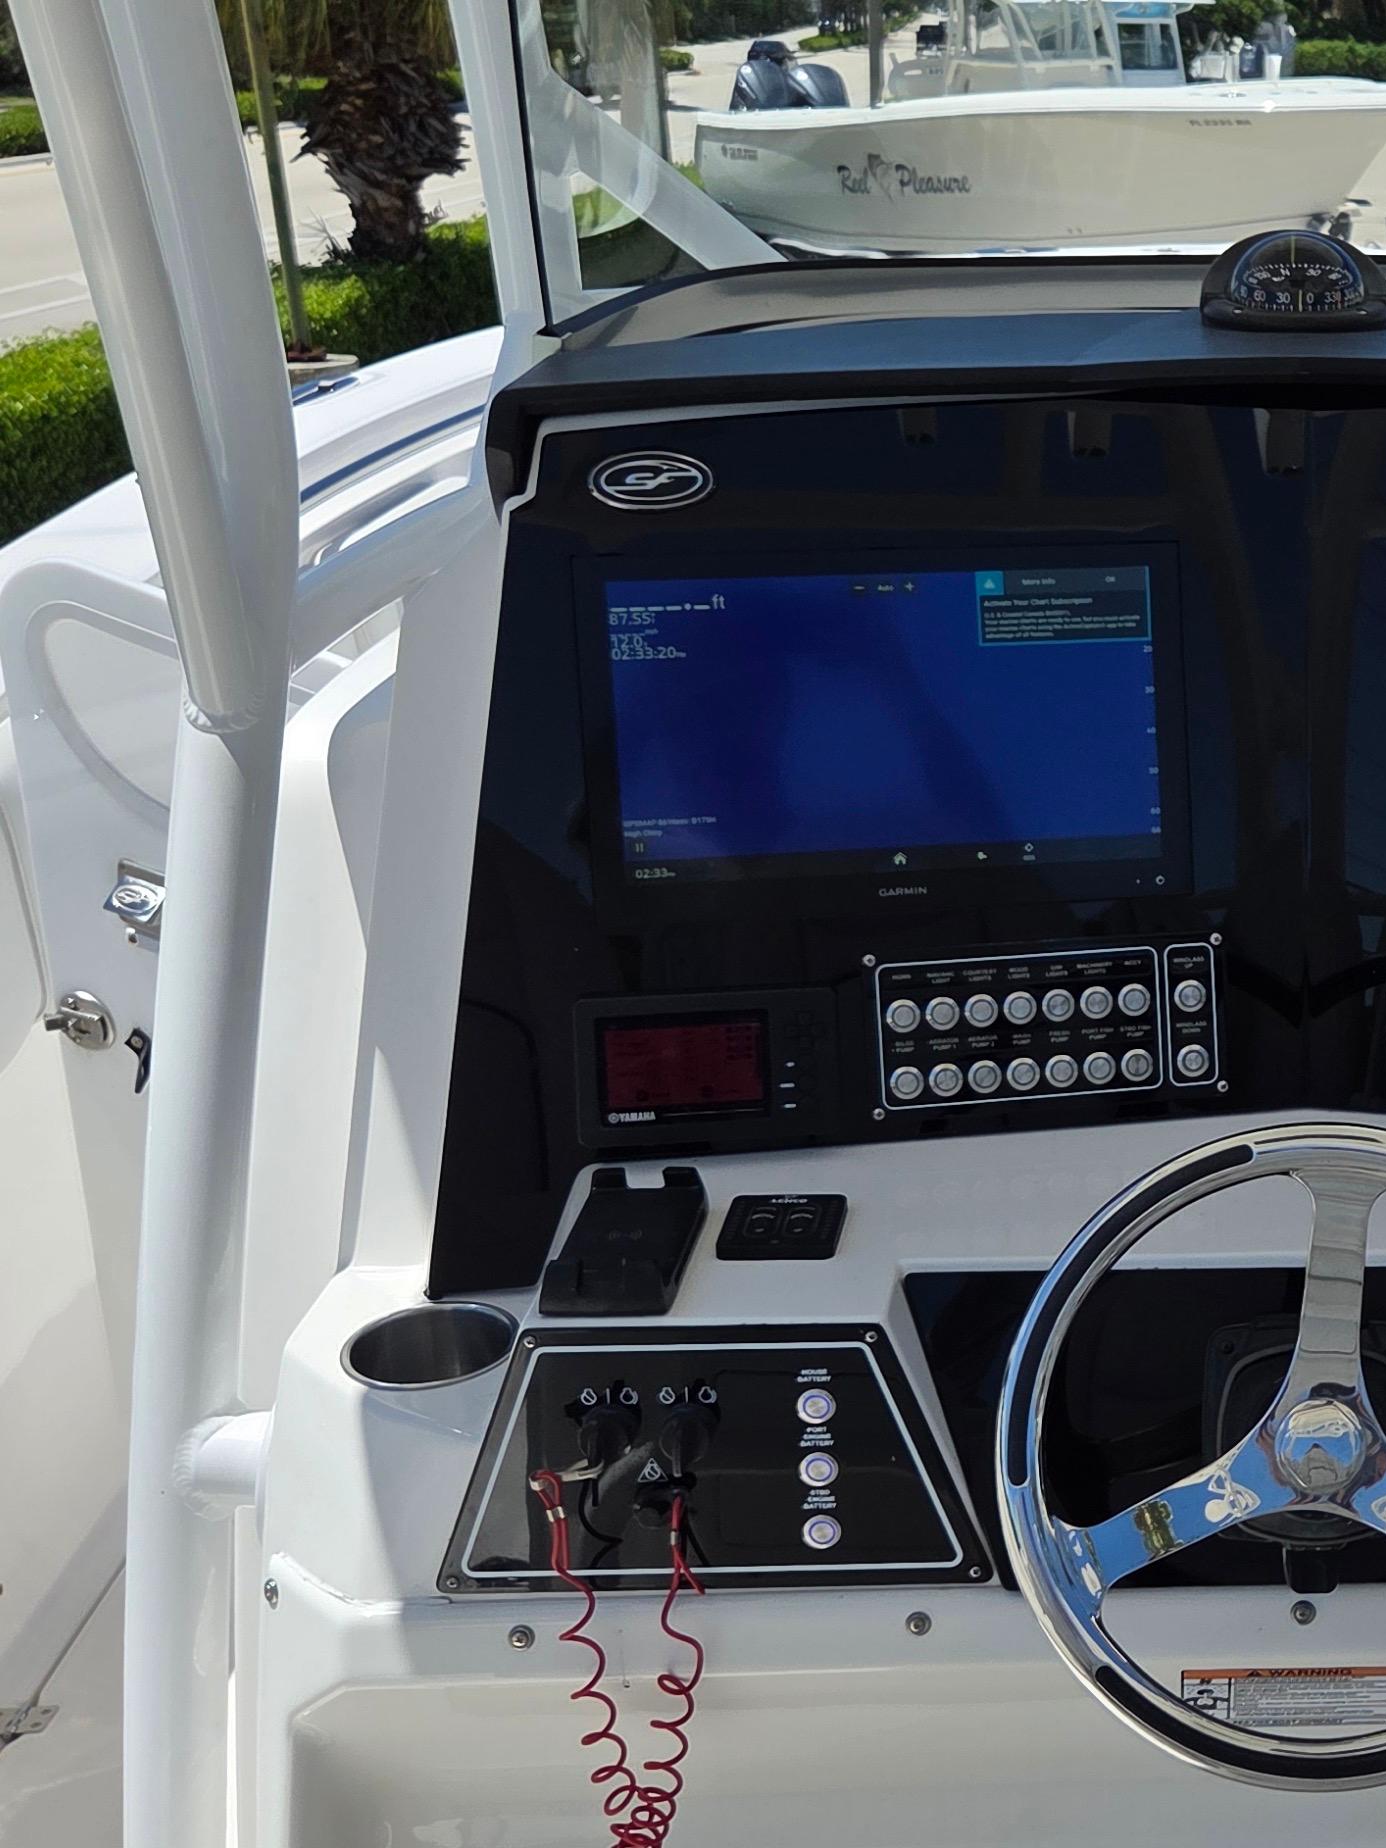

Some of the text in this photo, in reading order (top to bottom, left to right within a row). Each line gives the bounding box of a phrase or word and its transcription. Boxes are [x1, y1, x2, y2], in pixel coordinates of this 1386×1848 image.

[895, 163, 972, 197] Pleasure
[1276, 292, 1291, 303] 30
[612, 646, 687, 661] 02:33:20
[635, 867, 676, 879] 02:33
[878, 886, 928, 897] GARMIN
[620, 1111, 657, 1123] YAMAHA
[797, 1375, 832, 1383] BATTERY
[800, 1439, 834, 1447] BATTERY
[803, 1502, 837, 1510] BATTERY
[1268, 1667, 1353, 1677] WARNING
